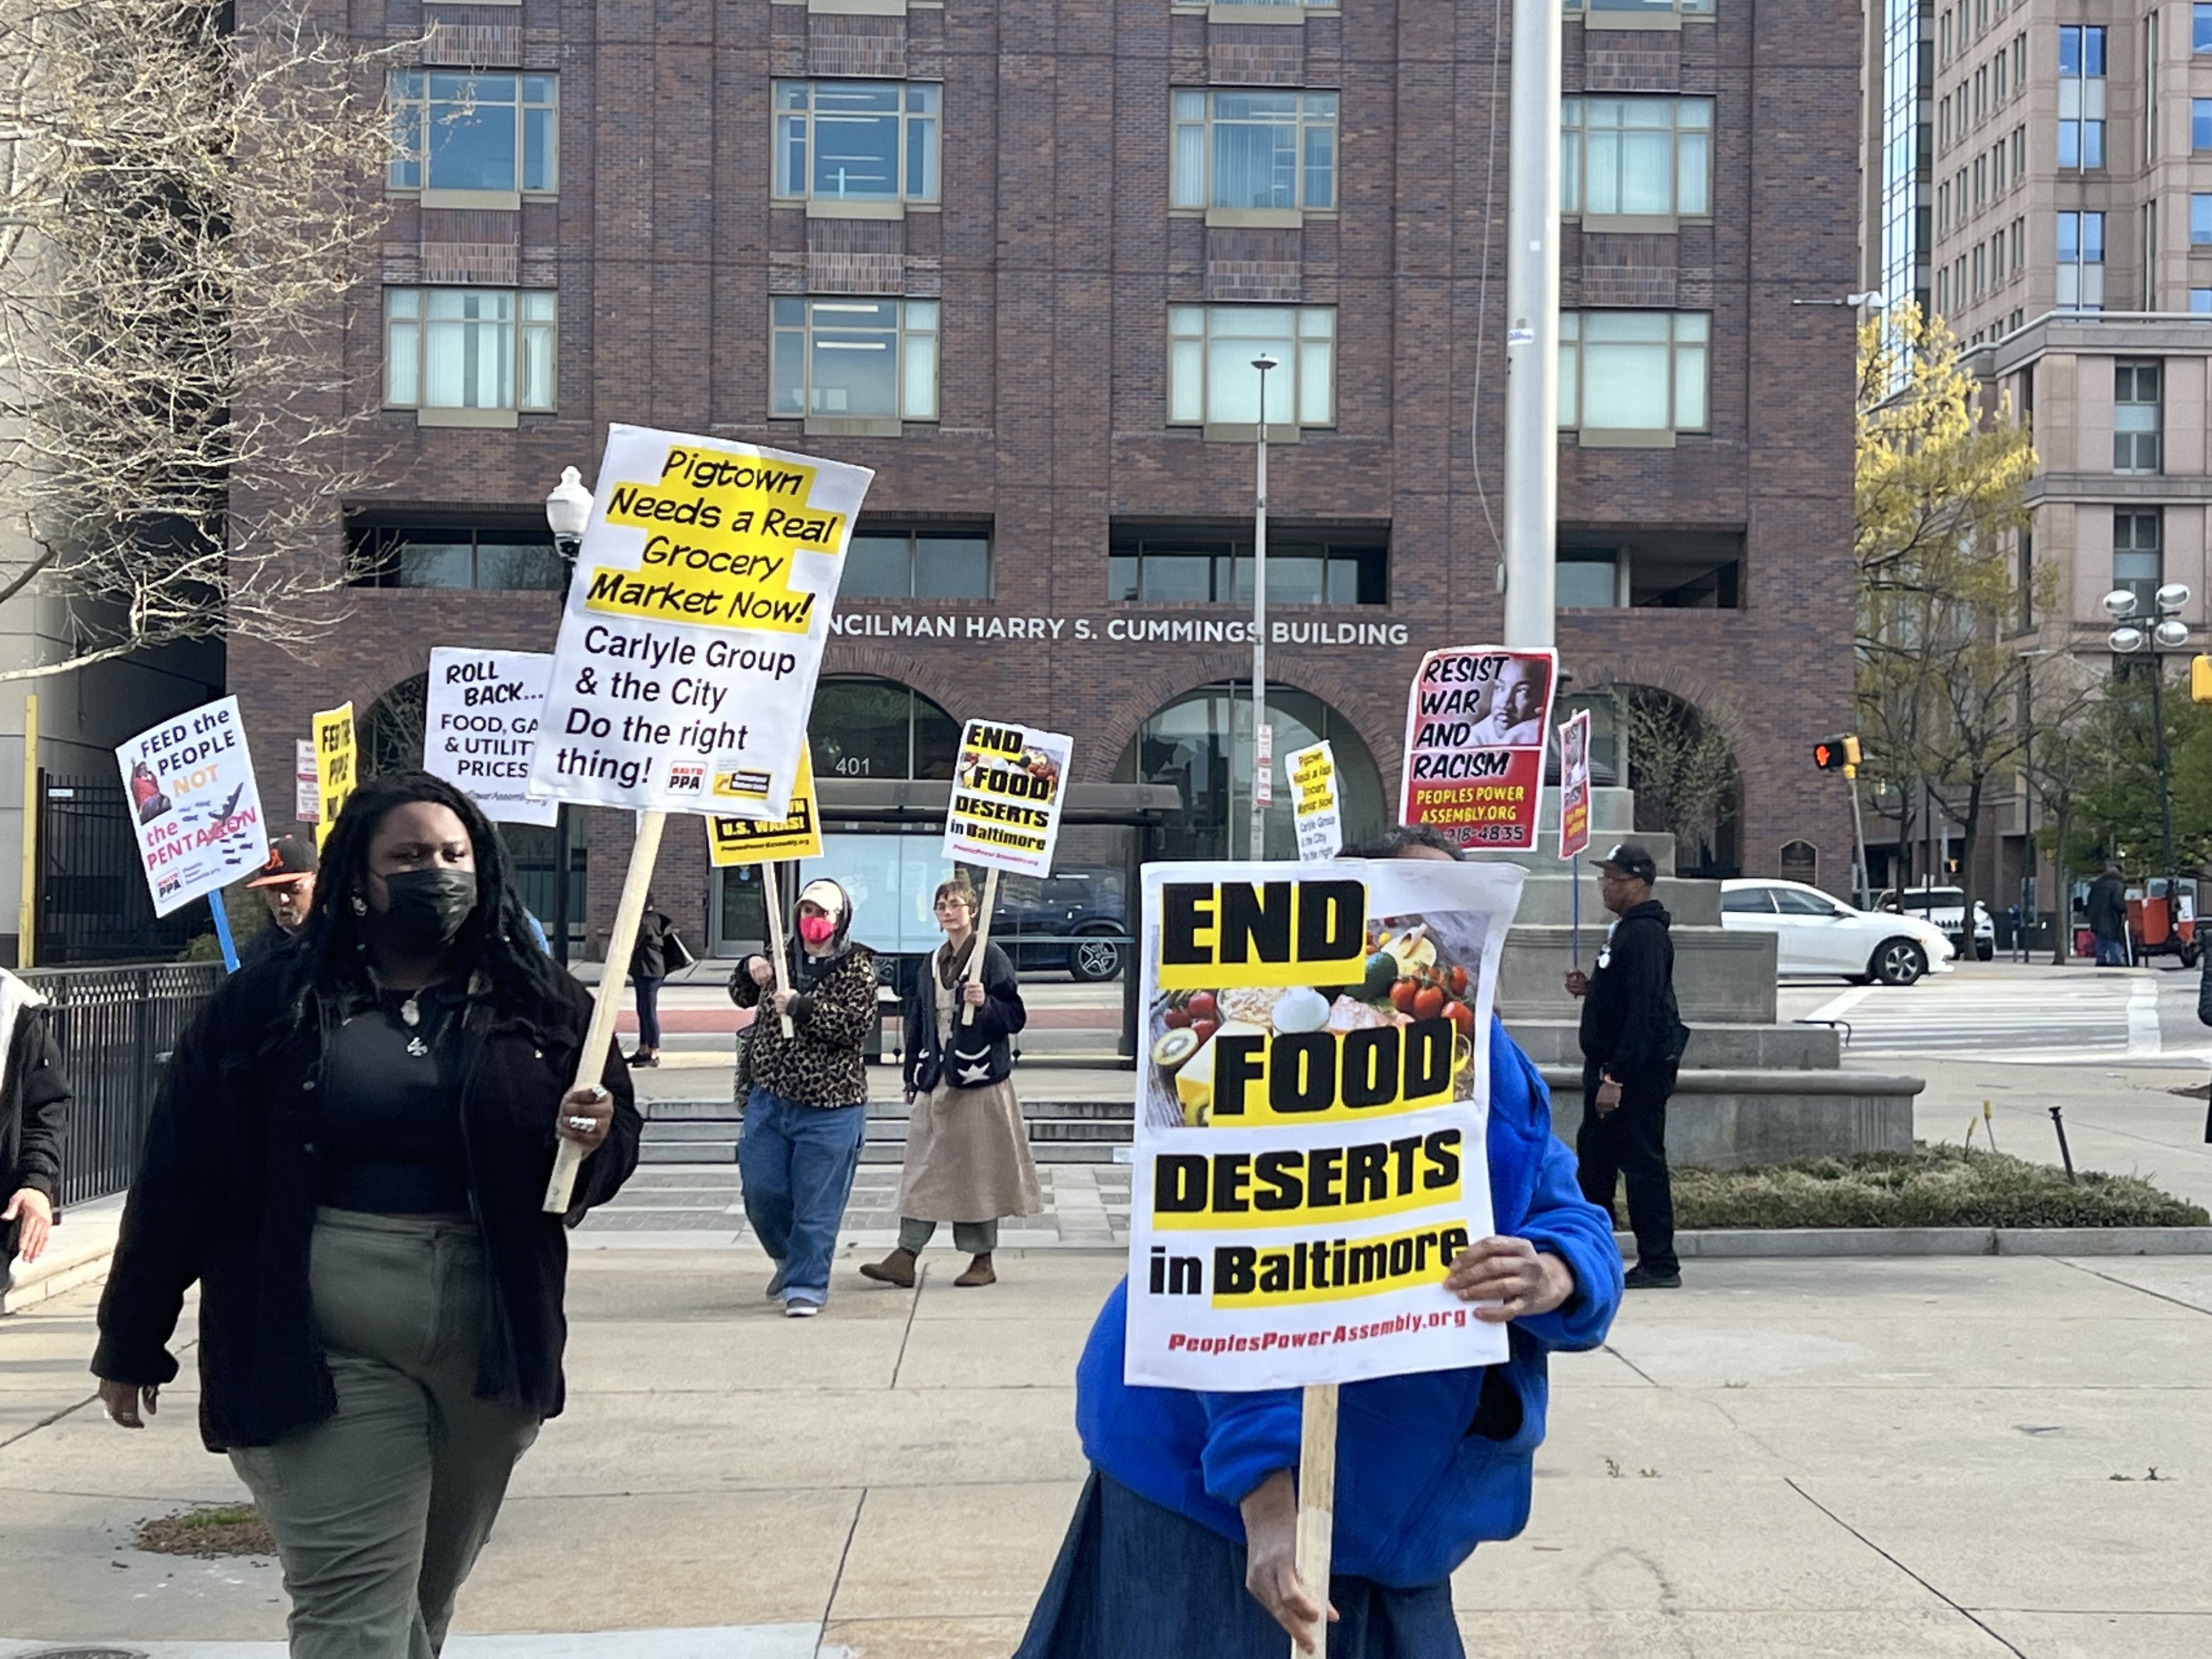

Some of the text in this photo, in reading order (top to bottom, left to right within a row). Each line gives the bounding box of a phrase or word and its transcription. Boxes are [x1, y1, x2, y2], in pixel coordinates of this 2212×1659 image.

[662, 450, 804, 495] Pigtown
[606, 488, 837, 544] Needs a Real
[642, 535, 784, 582] Grocery
[586, 573, 816, 623] Market Now!
[966, 617, 1065, 639] HARRY
[1074, 619, 1097, 640] S.
[1272, 622, 1409, 645] BUILDING
[585, 625, 796, 680] Carlyle Group
[447, 661, 499, 684] ROLL
[1423, 657, 1510, 684] RESIST
[575, 667, 727, 714] & the City
[1421, 689, 1480, 716] WAR
[140, 709, 229, 759] FEED the
[441, 713, 507, 736] FOOD,
[565, 707, 749, 754] Do the right
[967, 724, 1023, 753] END
[1415, 723, 1471, 748] AND
[157, 729, 235, 776] PEOPLE
[444, 736, 459, 753] &
[172, 763, 218, 797] NOT
[457, 760, 529, 777] PRICES
[557, 748, 652, 788] thing!
[669, 776, 700, 789] PPA
[836, 757, 869, 775] 401
[973, 766, 1049, 800] FOOD
[1413, 752, 1510, 780] RACISM
[955, 795, 1049, 827] DESERTS
[1417, 786, 1525, 805] PEOPLES POWER
[146, 821, 178, 847] the
[146, 806, 256, 871] PENTAGON
[721, 822, 751, 836] U.S.
[950, 819, 1046, 850] in Baltimore
[1162, 879, 1365, 965] END
[1213, 1018, 1453, 1116] FOOD
[1154, 1128, 1462, 1213] DESERTS
[1149, 1227, 1470, 1295] in Baltimore
[1169, 1308, 1467, 1356] PeoplesPowerAssembly.org
